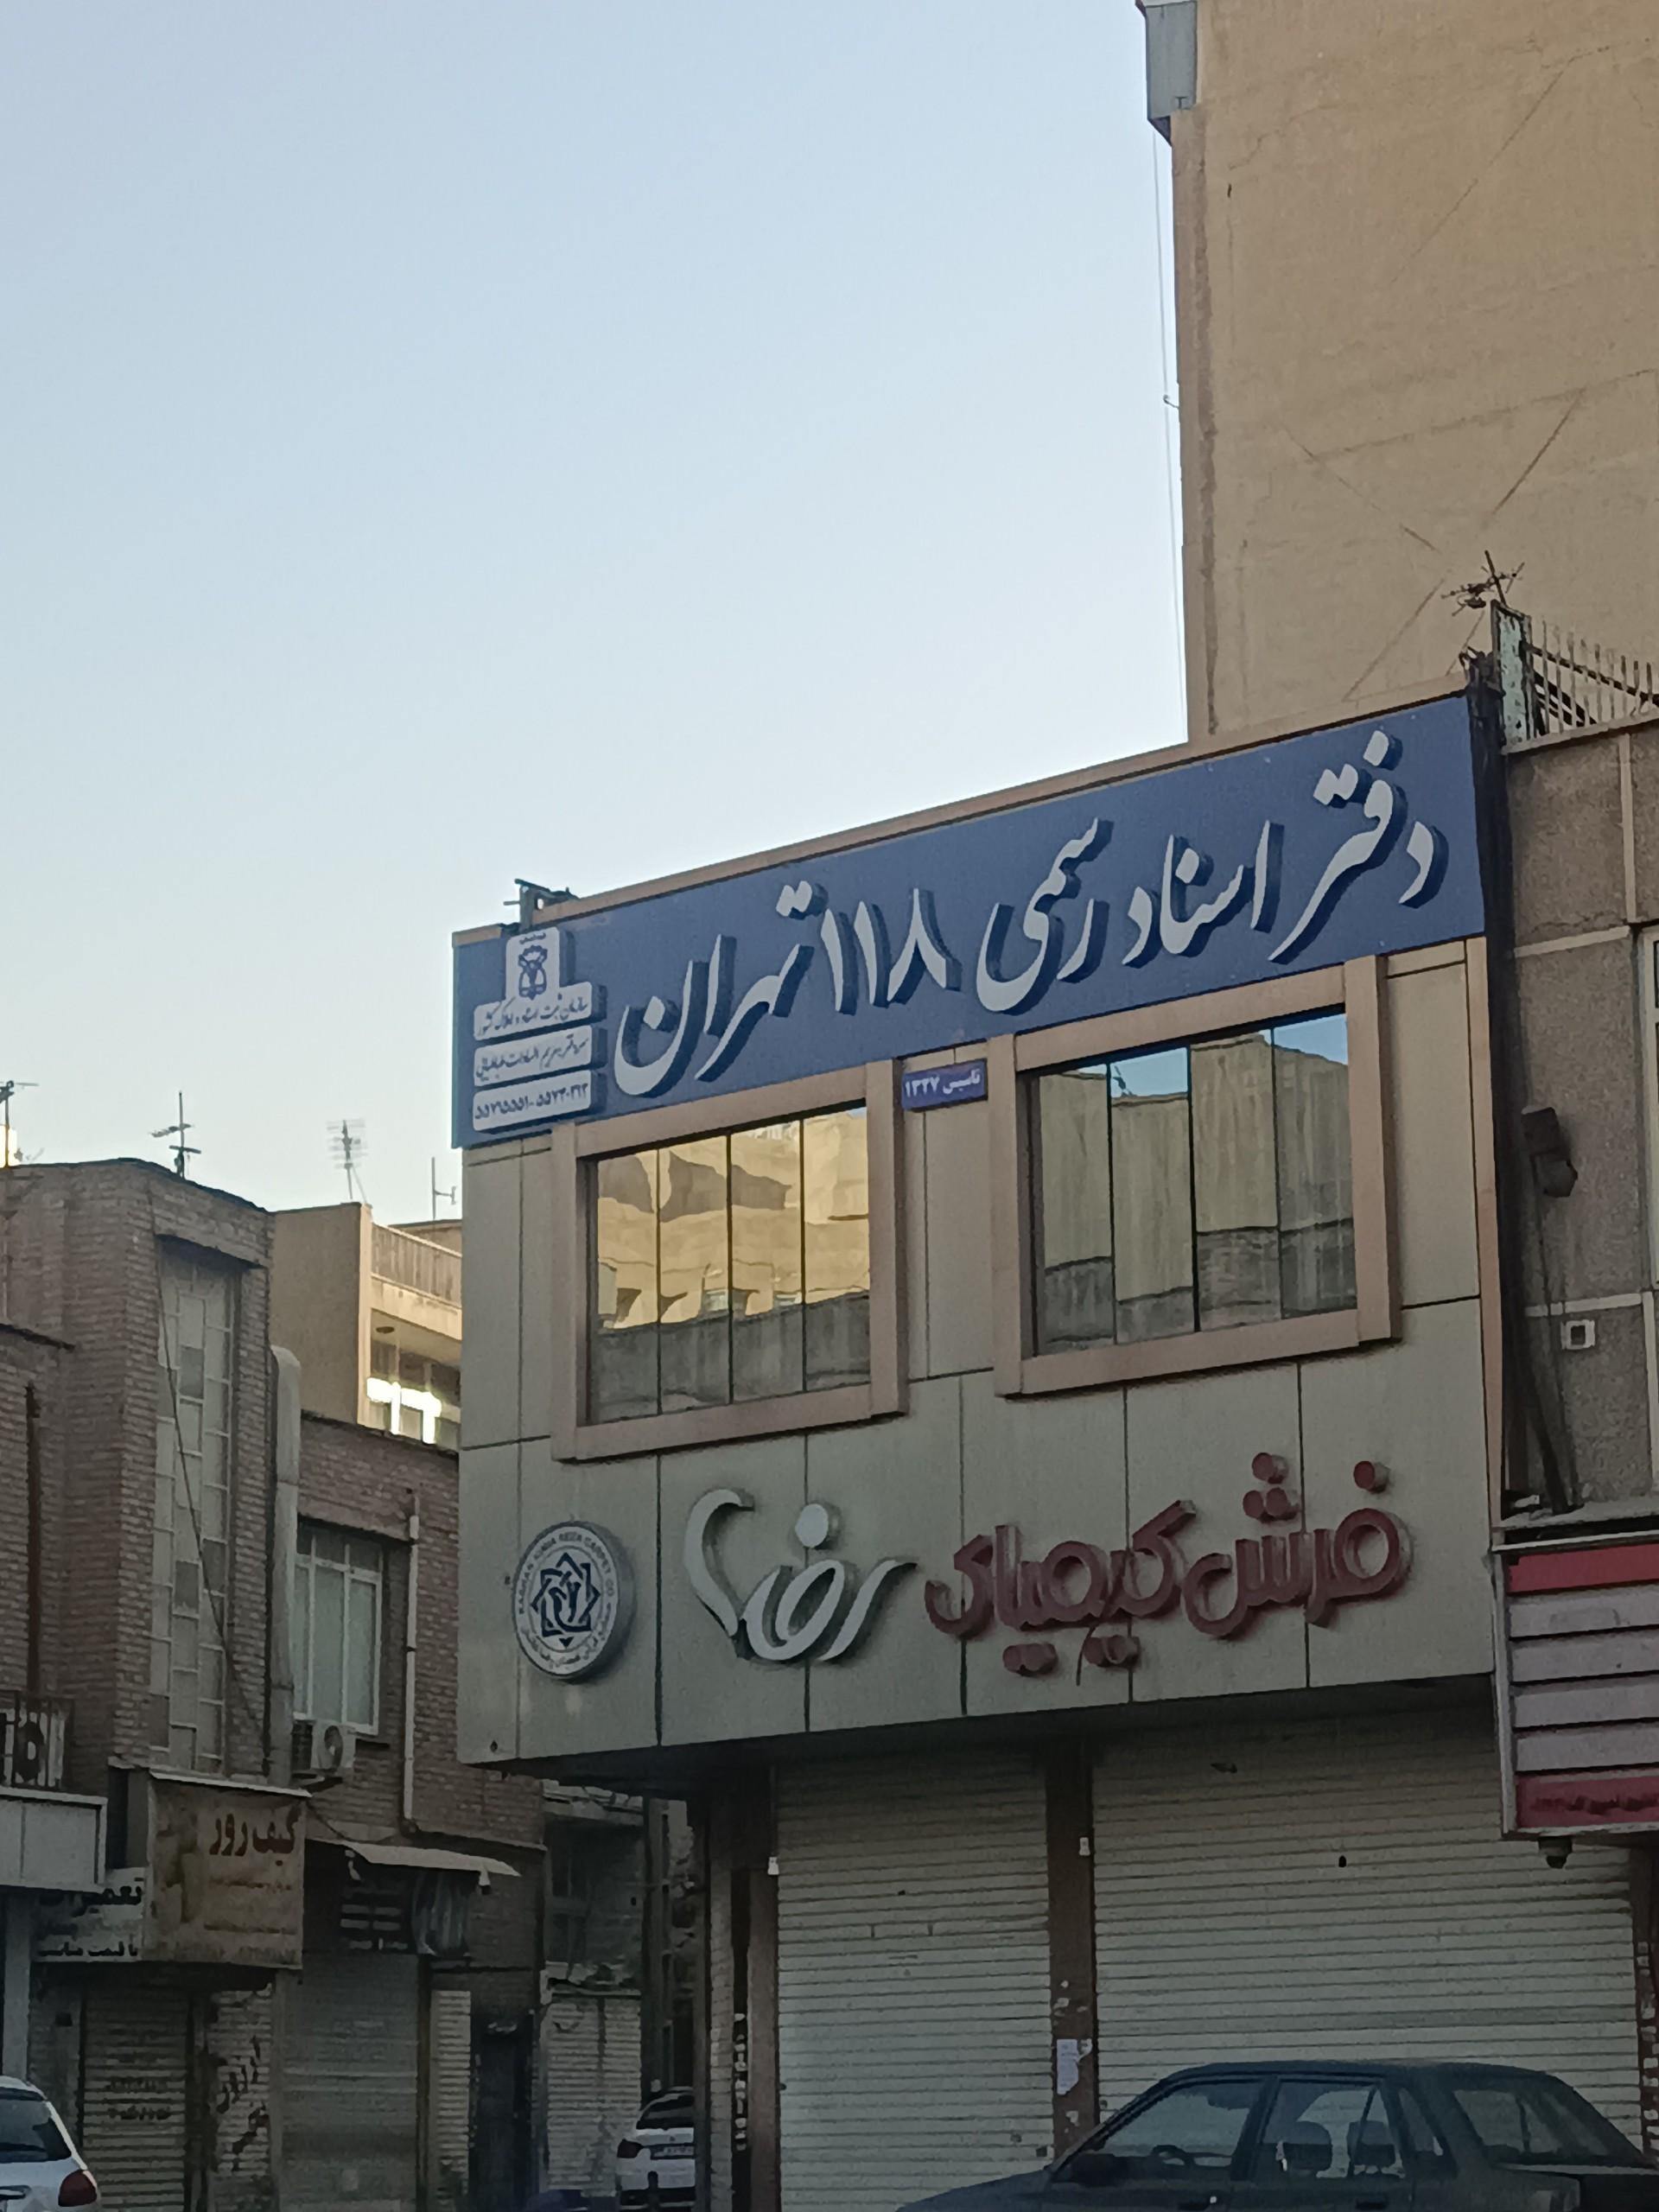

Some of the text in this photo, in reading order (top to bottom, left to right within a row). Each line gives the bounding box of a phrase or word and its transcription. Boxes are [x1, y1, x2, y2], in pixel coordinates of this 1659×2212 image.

[614, 730, 1443, 1095] دفتر اسناد رسمی ۱۱۸ تهران
[684, 1452, 1410, 1675] فرش کیمیای رضا
